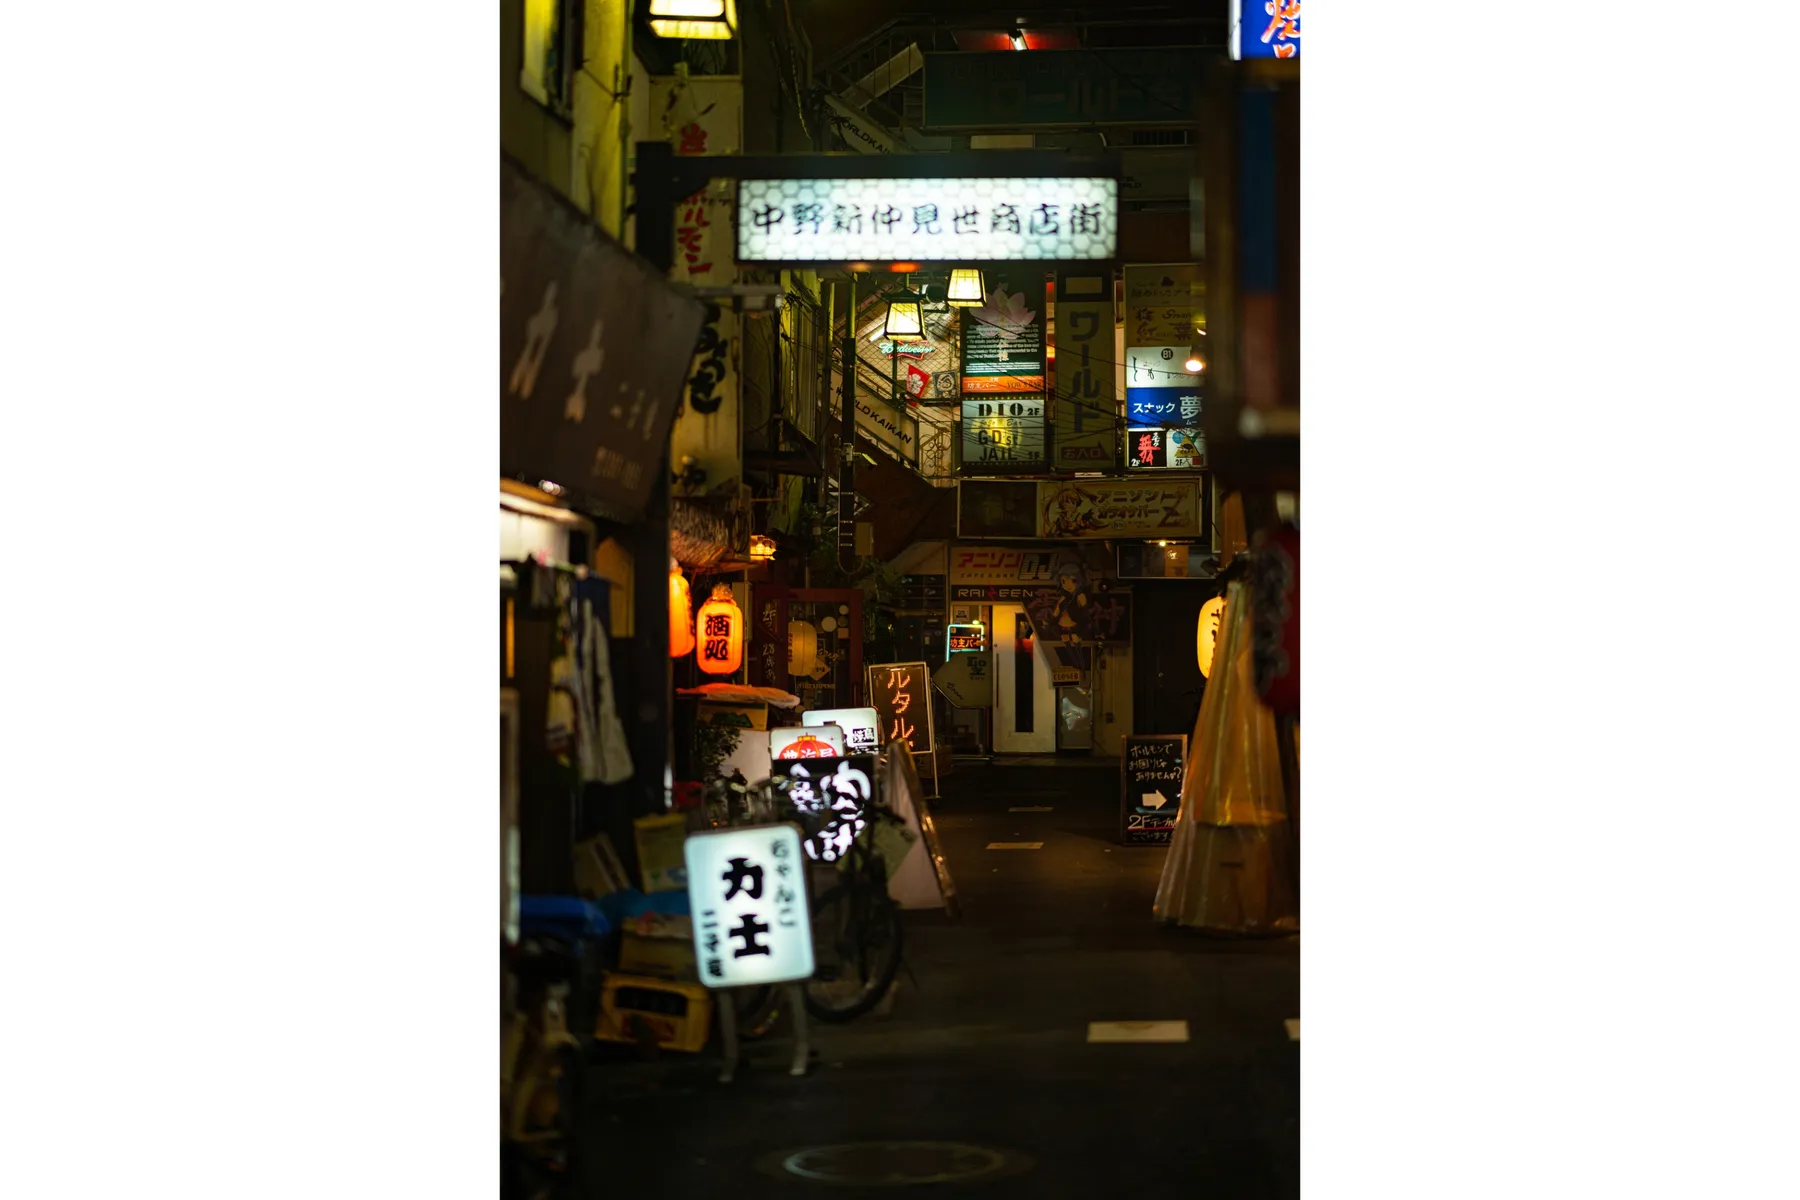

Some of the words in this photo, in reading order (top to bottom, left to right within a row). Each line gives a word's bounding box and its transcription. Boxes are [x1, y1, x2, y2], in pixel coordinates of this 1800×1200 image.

[753, 203, 1101, 235] 中野新仲見世商店街
[1069, 311, 1101, 434] ワールド
[979, 403, 1024, 416] DIO
[1028, 408, 1040, 416] 2F
[1133, 402, 1176, 414] スナック
[1179, 396, 1203, 419] 夢
[958, 553, 1022, 568] アニソン
[1053, 672, 1079, 681] CLOSED
[722, 858, 771, 959] 力士
